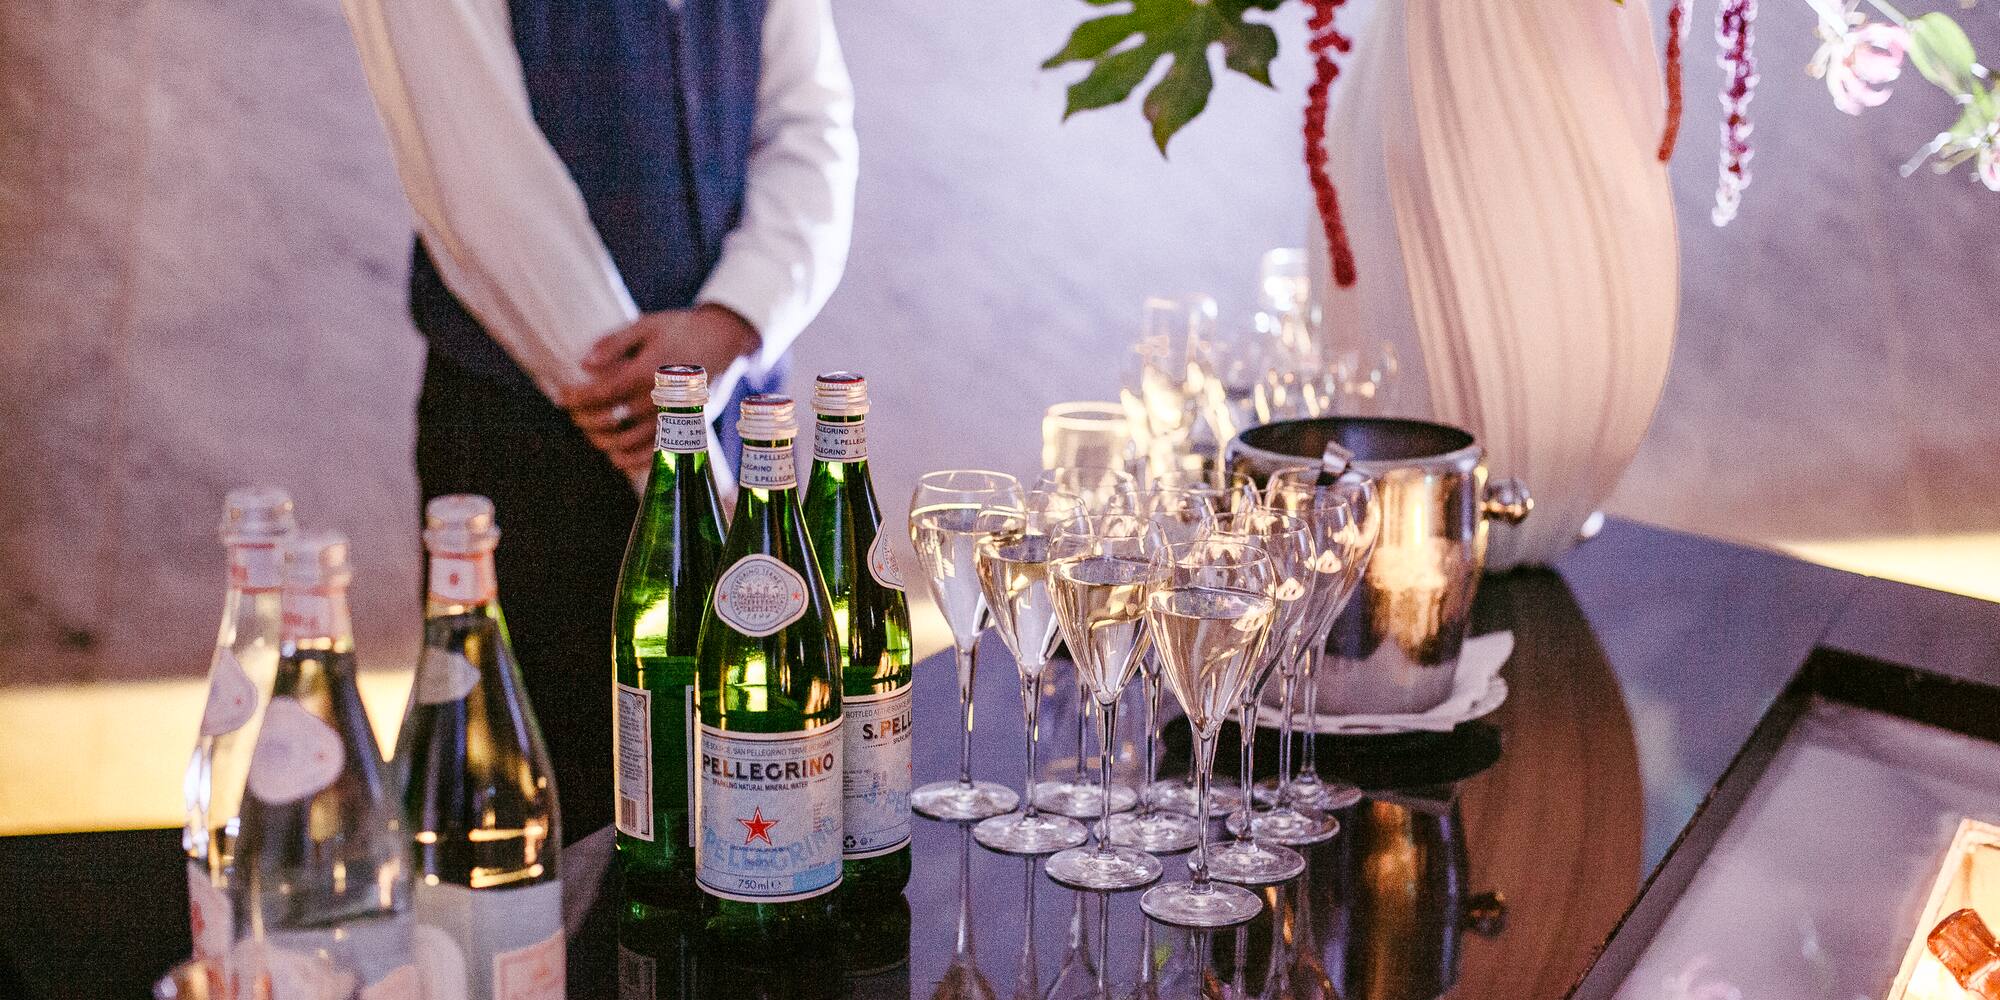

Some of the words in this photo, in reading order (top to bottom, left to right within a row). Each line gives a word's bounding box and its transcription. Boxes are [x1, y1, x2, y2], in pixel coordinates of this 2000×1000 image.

[661, 416, 702, 426] PELLEGRINO
[660, 438, 701, 446] PELLEGRINO
[845, 709, 873, 719] BOTTLED
[733, 748, 746, 756] SAN
[746, 748, 787, 757] PELLEGRINO
[702, 752, 834, 780] PELLEGRINO
[739, 782, 763, 792] NATURAL
[764, 782, 789, 792] MINERAL
[790, 780, 809, 790] WATER
